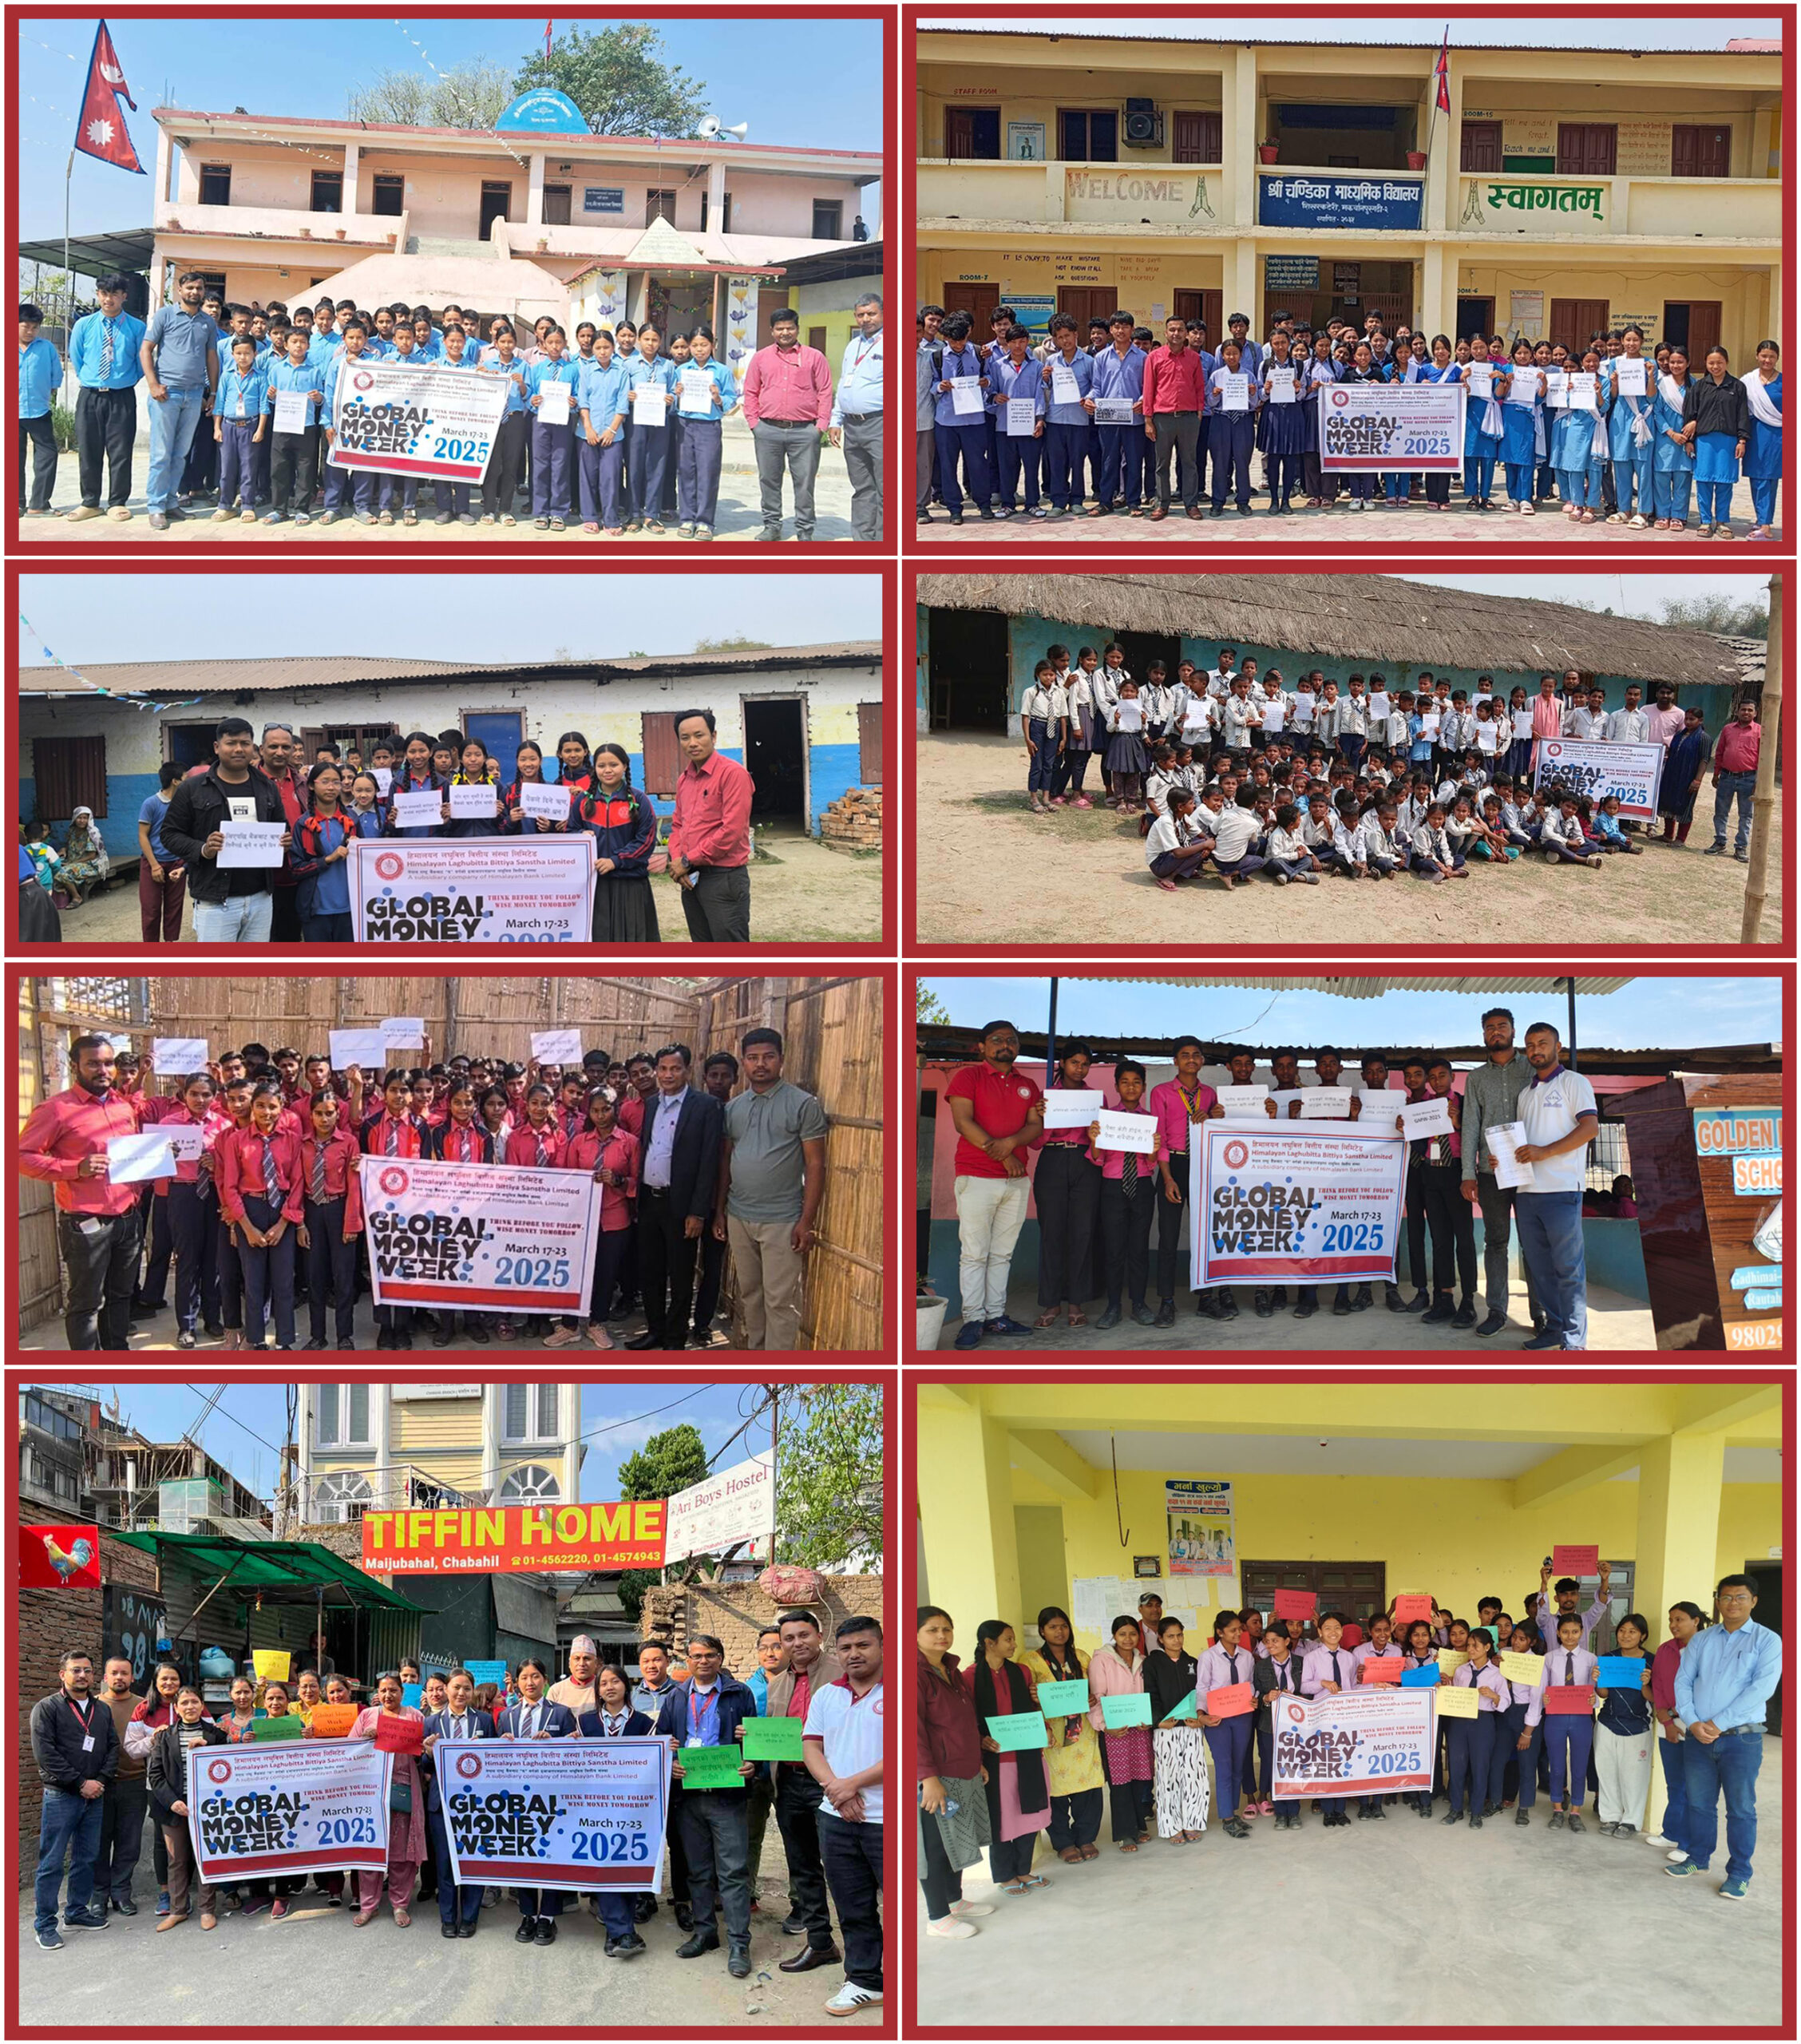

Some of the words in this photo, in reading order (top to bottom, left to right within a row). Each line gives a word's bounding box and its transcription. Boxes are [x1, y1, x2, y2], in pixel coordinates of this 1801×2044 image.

[1268, 180, 1283, 197] श्री
[1286, 180, 1331, 199] चण्डिका
[1336, 183, 1381, 200] माध्यमिक
[1383, 182, 1419, 201] विद्यालय
[1488, 184, 1604, 220] स्वागतम्
[342, 402, 434, 424] GLOBAL
[1327, 416, 1402, 429] GLOBAL
[341, 418, 425, 438] MONEY
[442, 427, 468, 436] March
[469, 430, 488, 439] 17-23
[1327, 430, 1395, 442] MONEY
[340, 432, 409, 454] WEEK
[433, 438, 489, 463] 2025
[1326, 442, 1383, 454] WEEK
[1404, 438, 1451, 455] 2025
[1541, 763, 1605, 778] GLOBAL
[1606, 786, 1647, 804] 2025
[366, 896, 493, 918] GLOBAL
[366, 918, 481, 941] MONEY
[506, 919, 541, 928] March
[544, 919, 568, 930] 17-23
[1698, 1119, 1772, 1152] GOLDEN
[1213, 1186, 1321, 1209] GLOBAL
[369, 1211, 494, 1239] GLOBAL
[1213, 1208, 1311, 1231] MONEY
[1331, 1210, 1359, 1220] March
[1361, 1212, 1382, 1222] 17-23
[373, 1234, 481, 1260] MONEY
[1213, 1230, 1293, 1253] WEEK
[1322, 1224, 1383, 1252] 2025
[505, 1244, 540, 1254] March
[543, 1246, 567, 1257] 17-23
[495, 1257, 570, 1287] 2025
[675, 1499, 691, 1516] Ari
[695, 1487, 722, 1508] Boys
[726, 1465, 767, 1495] Hostel
[365, 1510, 505, 1548] TIFFIN
[521, 1503, 663, 1545] HOME
[366, 1556, 438, 1571] Maijubahal,
[443, 1555, 500, 1568] Chabahil
[523, 1554, 590, 1566] 01-4562220,
[593, 1551, 661, 1564] 01-4574943
[1279, 1730, 1364, 1749] GLOBAL
[1277, 1746, 1356, 1764] MONEY
[1368, 1752, 1421, 1775] 2025
[1277, 1763, 1344, 1778] WEEK
[201, 1792, 310, 1817] GLOBAL
[322, 1807, 352, 1816] March
[355, 1806, 372, 1815] 17-23
[449, 1794, 567, 1815] GLOBAL
[201, 1812, 300, 1836] MONEY
[317, 1817, 376, 1845] 2025
[451, 1815, 555, 1835] MONEY
[579, 1818, 613, 1828] March
[617, 1820, 642, 1829] 17-23
[204, 1832, 287, 1855] WEEK
[454, 1836, 537, 1857] WEEK
[572, 1832, 649, 1861] 2025
